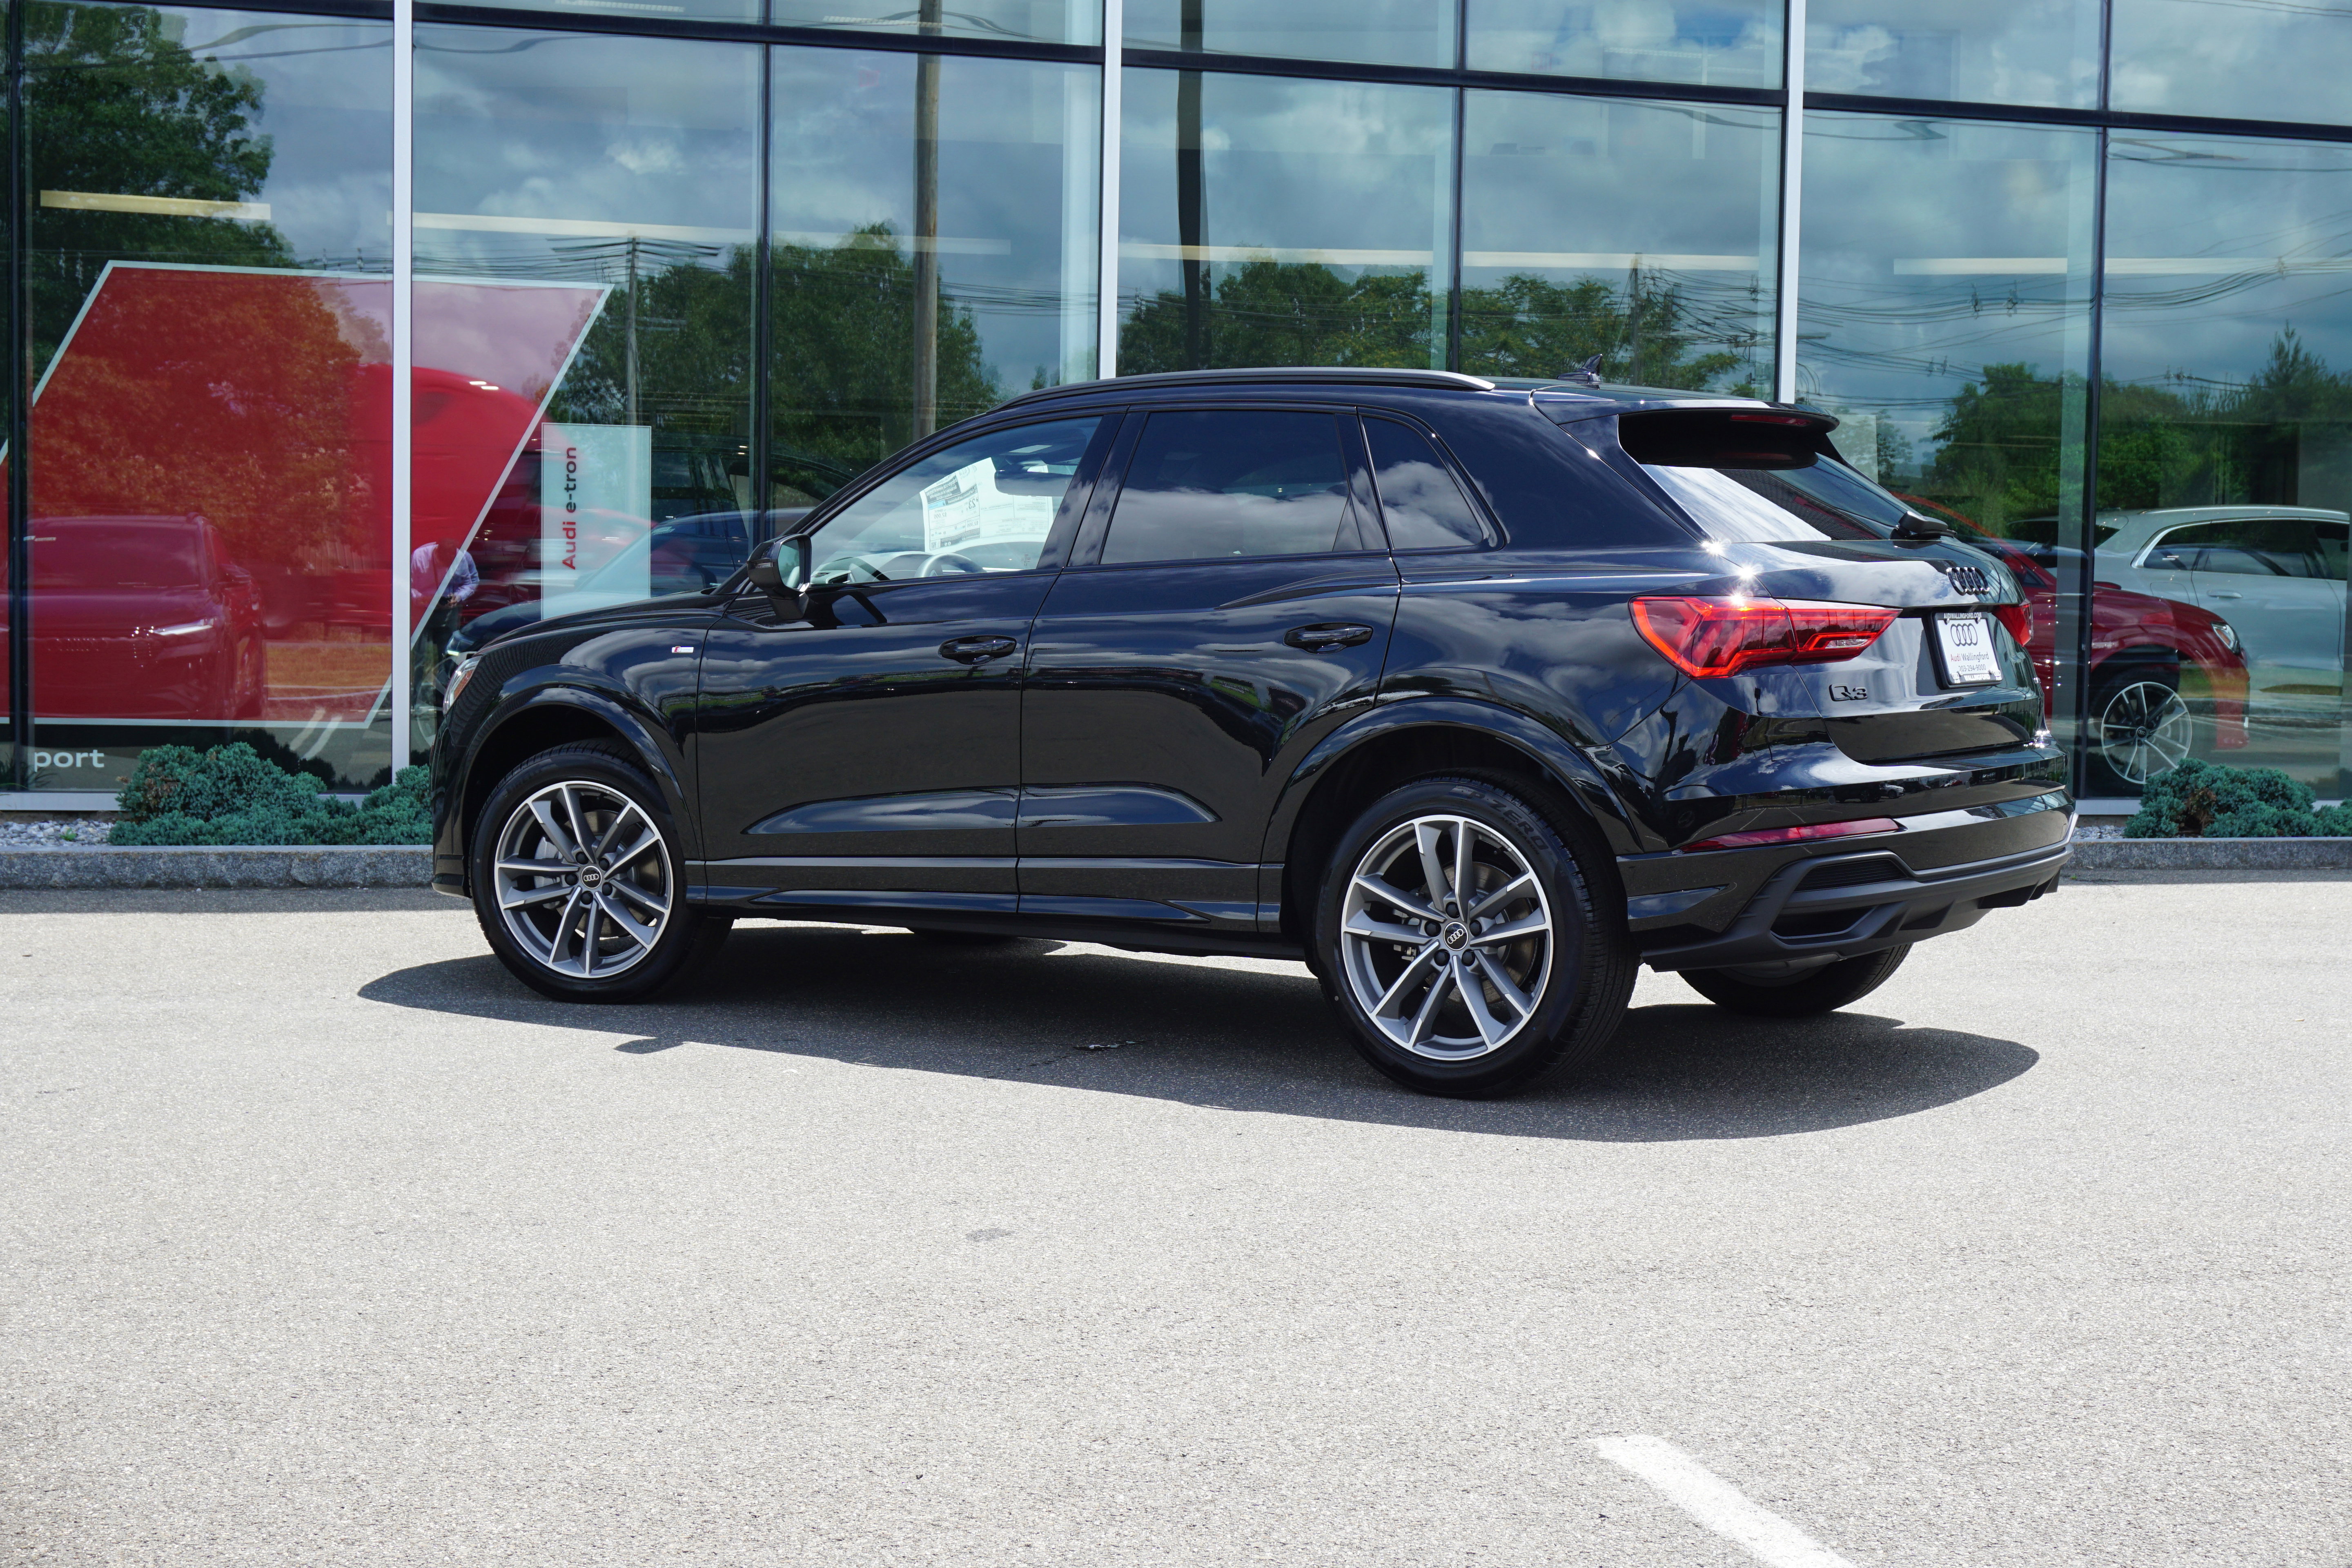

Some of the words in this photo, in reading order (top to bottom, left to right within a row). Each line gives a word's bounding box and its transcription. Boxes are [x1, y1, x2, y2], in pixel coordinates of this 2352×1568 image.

[564, 447, 576, 513] e-tron
[562, 521, 576, 570] Audi
[1961, 652, 1989, 663] Wallingford
[1829, 683, 1868, 702] Q3
[34, 749, 105, 773] port
[1487, 799, 1549, 850] ZERO
